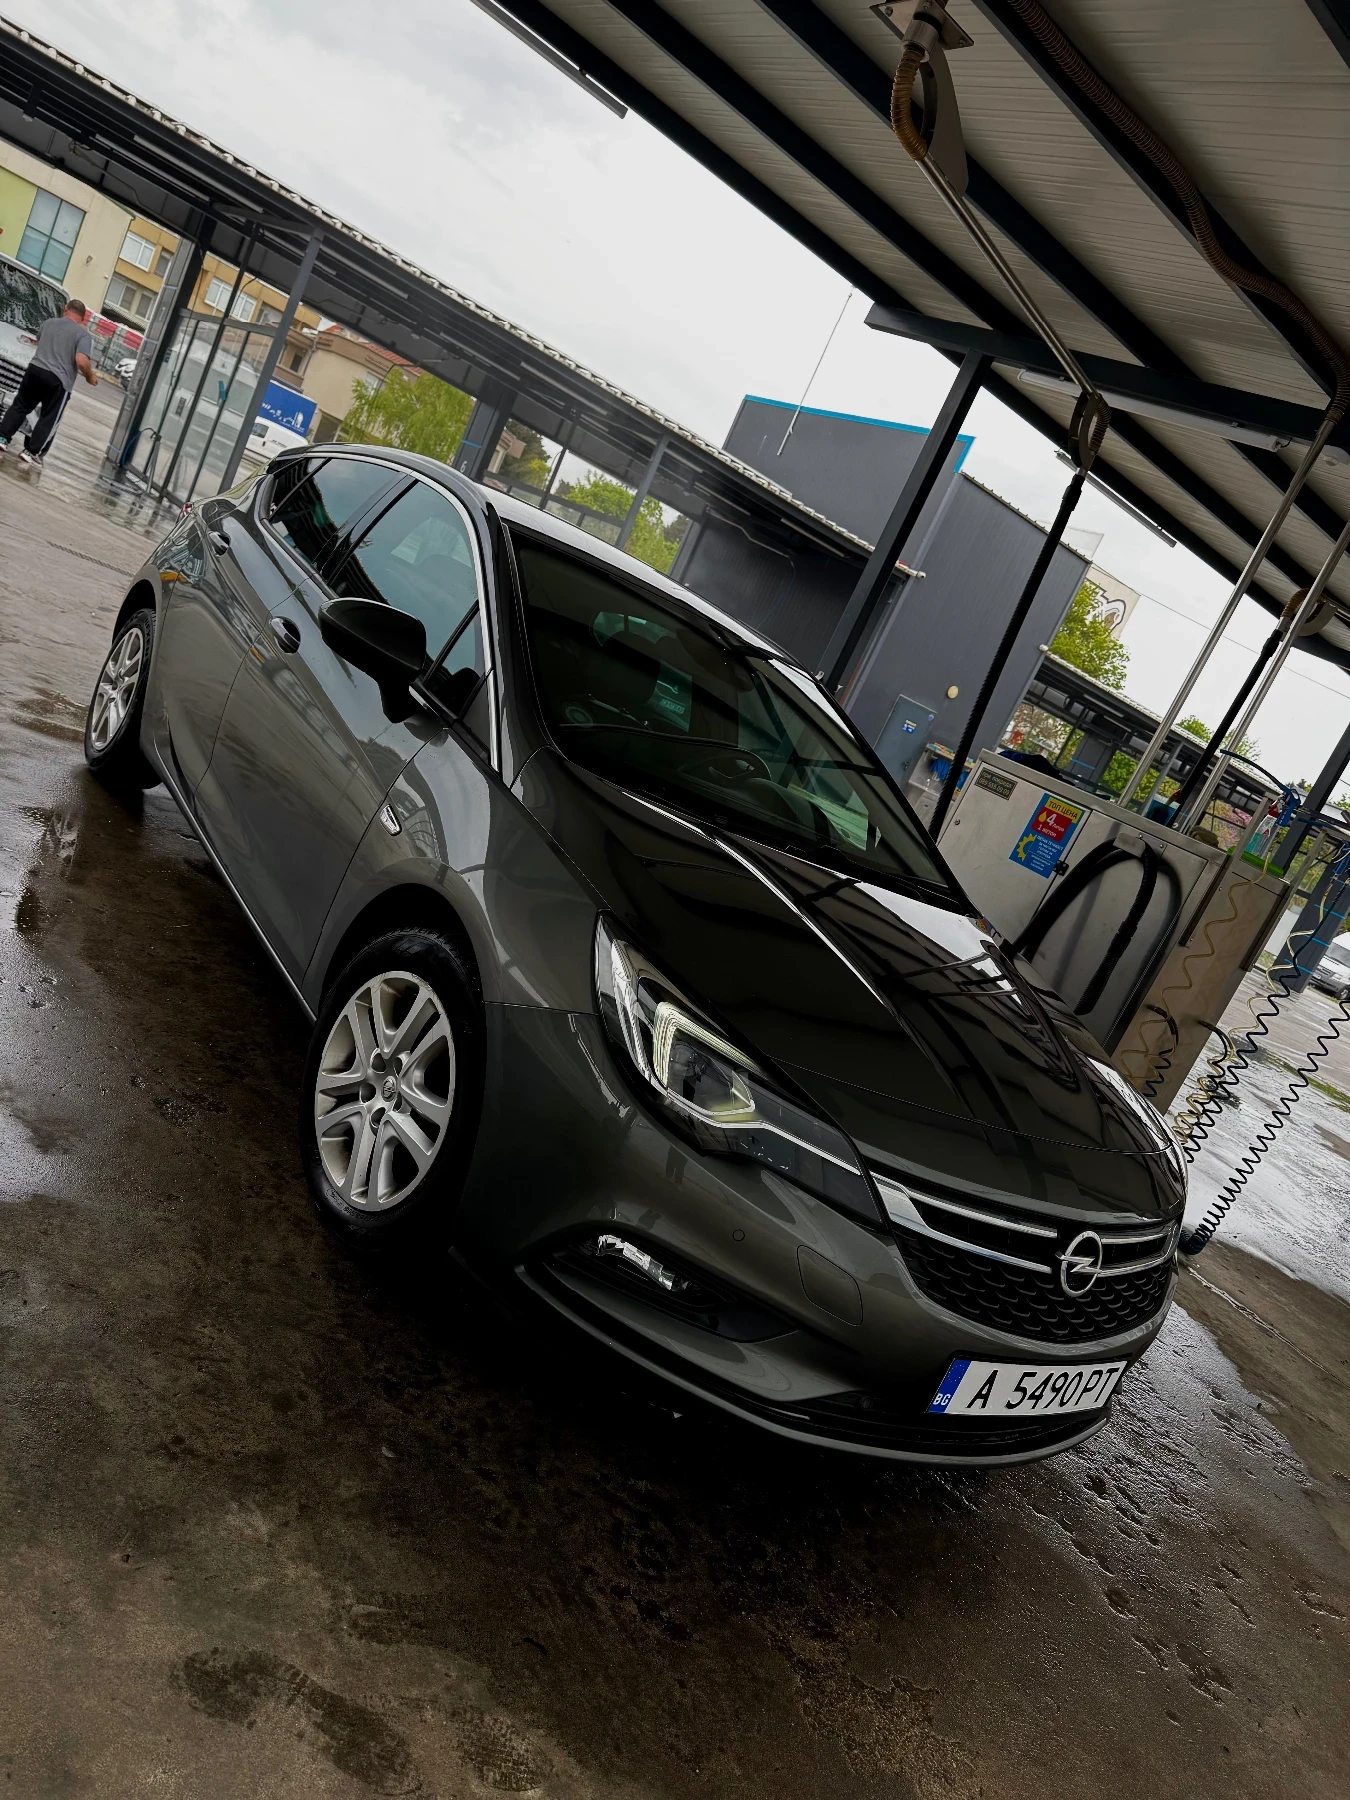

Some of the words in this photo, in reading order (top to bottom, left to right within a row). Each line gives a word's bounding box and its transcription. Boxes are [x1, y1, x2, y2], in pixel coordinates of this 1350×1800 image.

[460, 461, 468, 473] 6
[1048, 801, 1061, 811] ТОП
[1060, 806, 1078, 819] ЦЕНА
[1046, 813, 1057, 826] 4
[933, 1393, 951, 1406] BG
[965, 1369, 999, 1409] A
